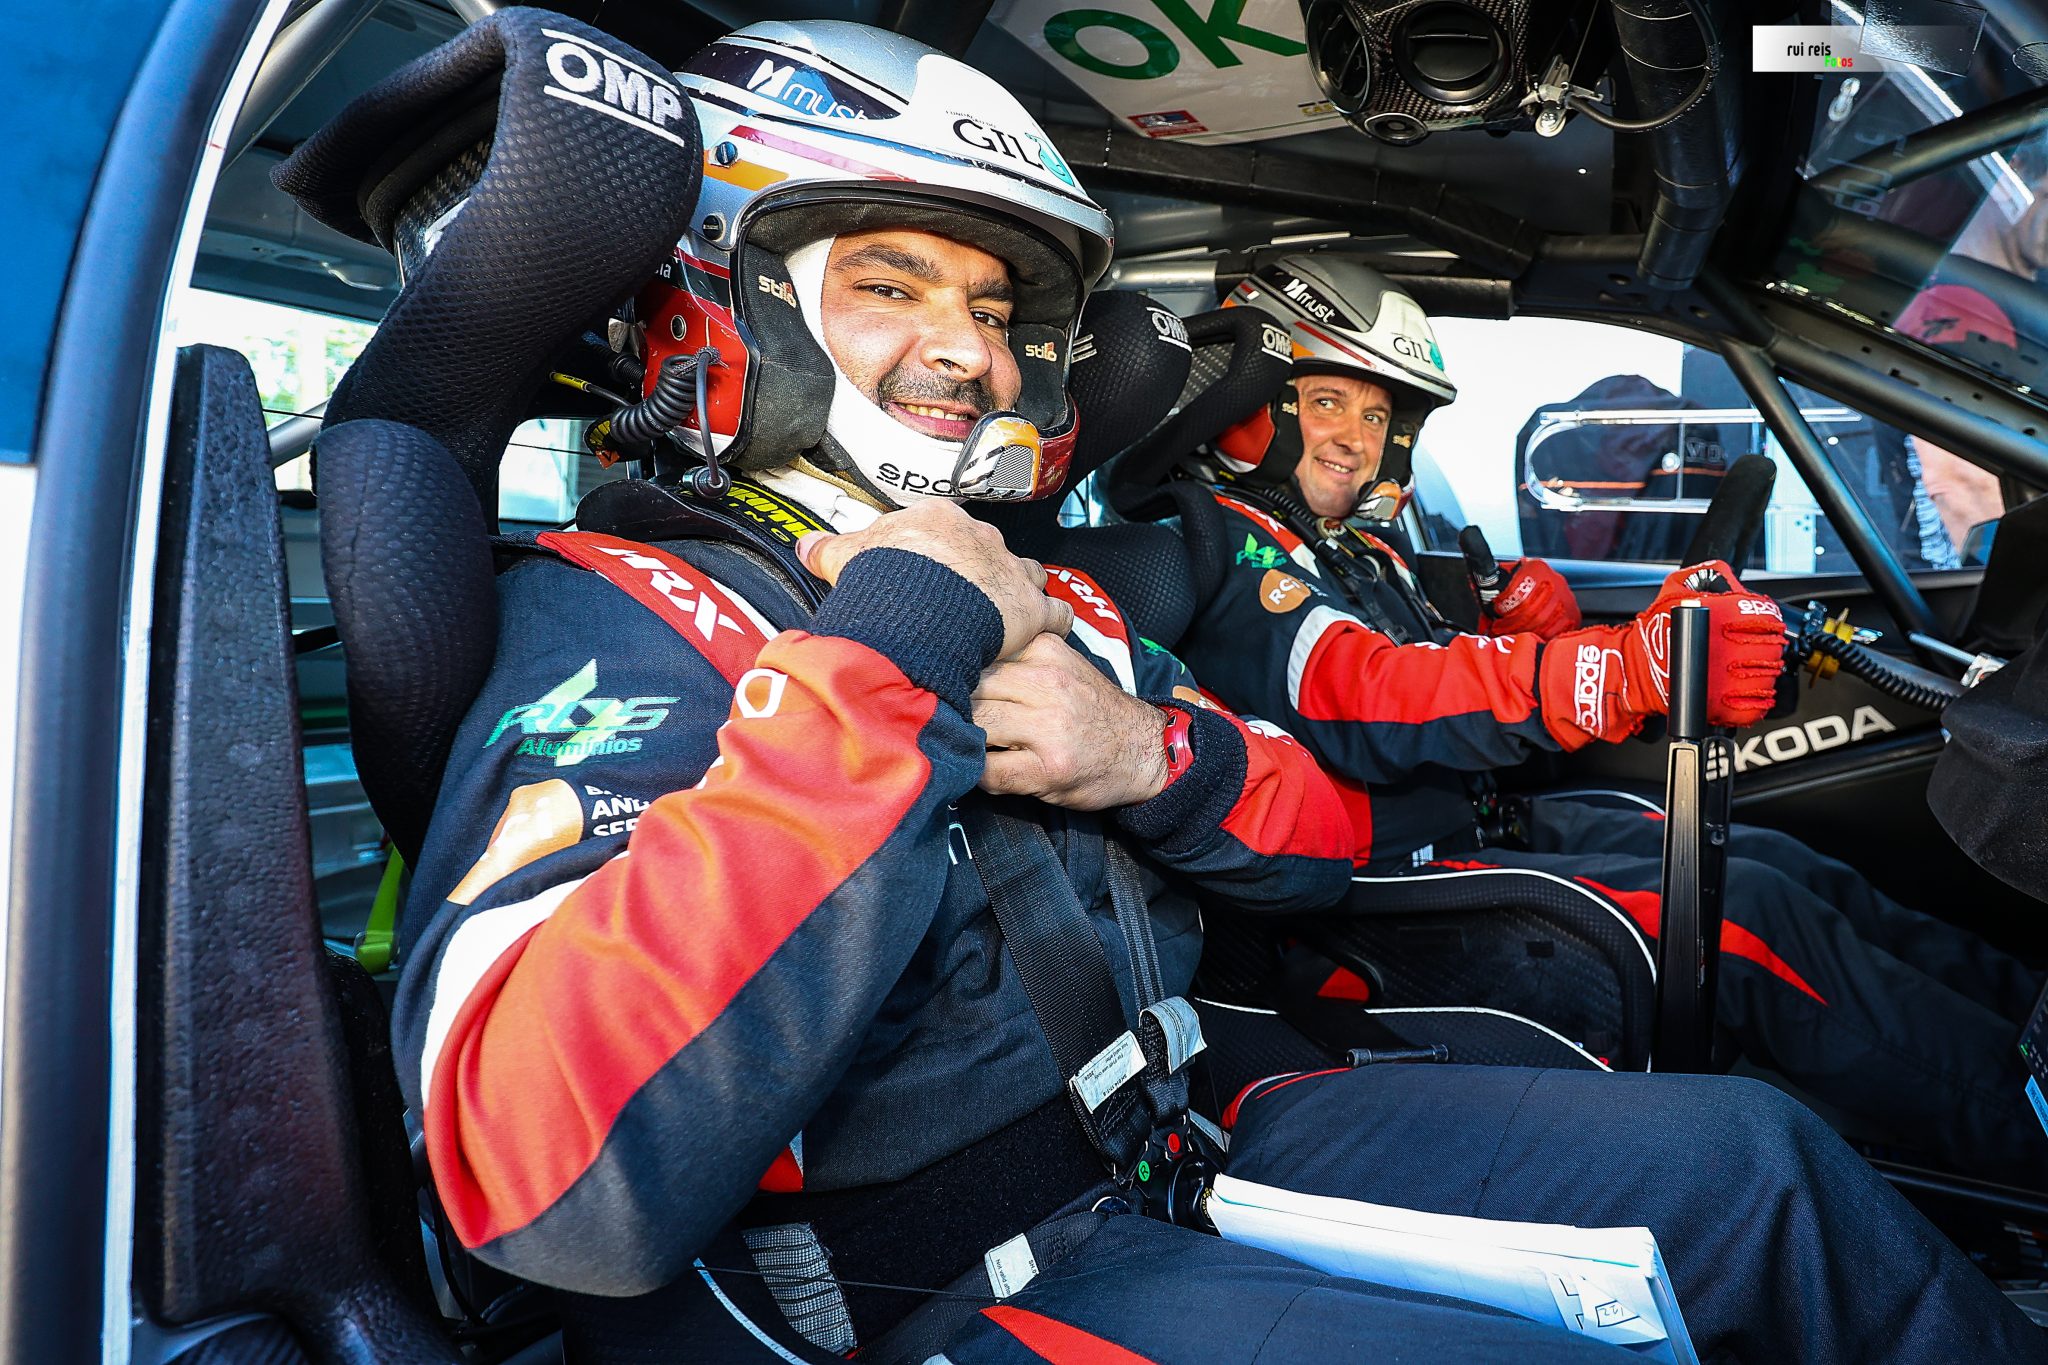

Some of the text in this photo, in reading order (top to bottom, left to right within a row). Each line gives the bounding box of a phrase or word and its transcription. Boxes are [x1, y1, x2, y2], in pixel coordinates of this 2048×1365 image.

[545, 41, 683, 126] OMP
[952, 118, 1045, 171] GIL
[1392, 336, 1431, 364] GIL
